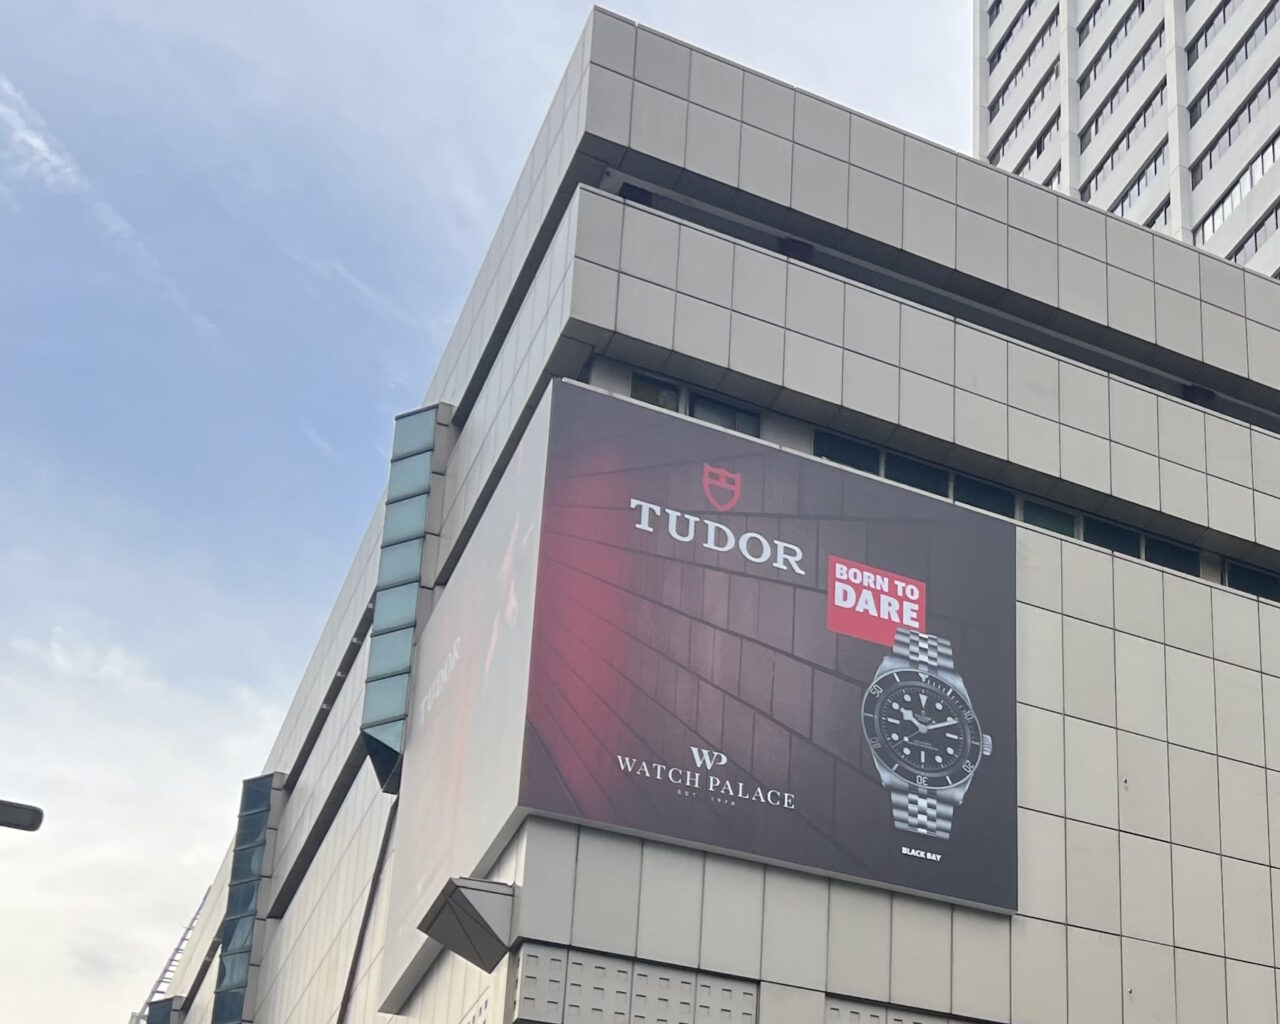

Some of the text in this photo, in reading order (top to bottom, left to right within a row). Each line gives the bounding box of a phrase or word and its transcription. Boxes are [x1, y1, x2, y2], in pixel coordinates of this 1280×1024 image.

[630, 498, 806, 576] TUDOR
[834, 581, 920, 629] DARE
[835, 562, 920, 601] BORN TO
[616, 755, 796, 809] WATCH PALACE
[901, 846, 942, 862] BLACK BAY
